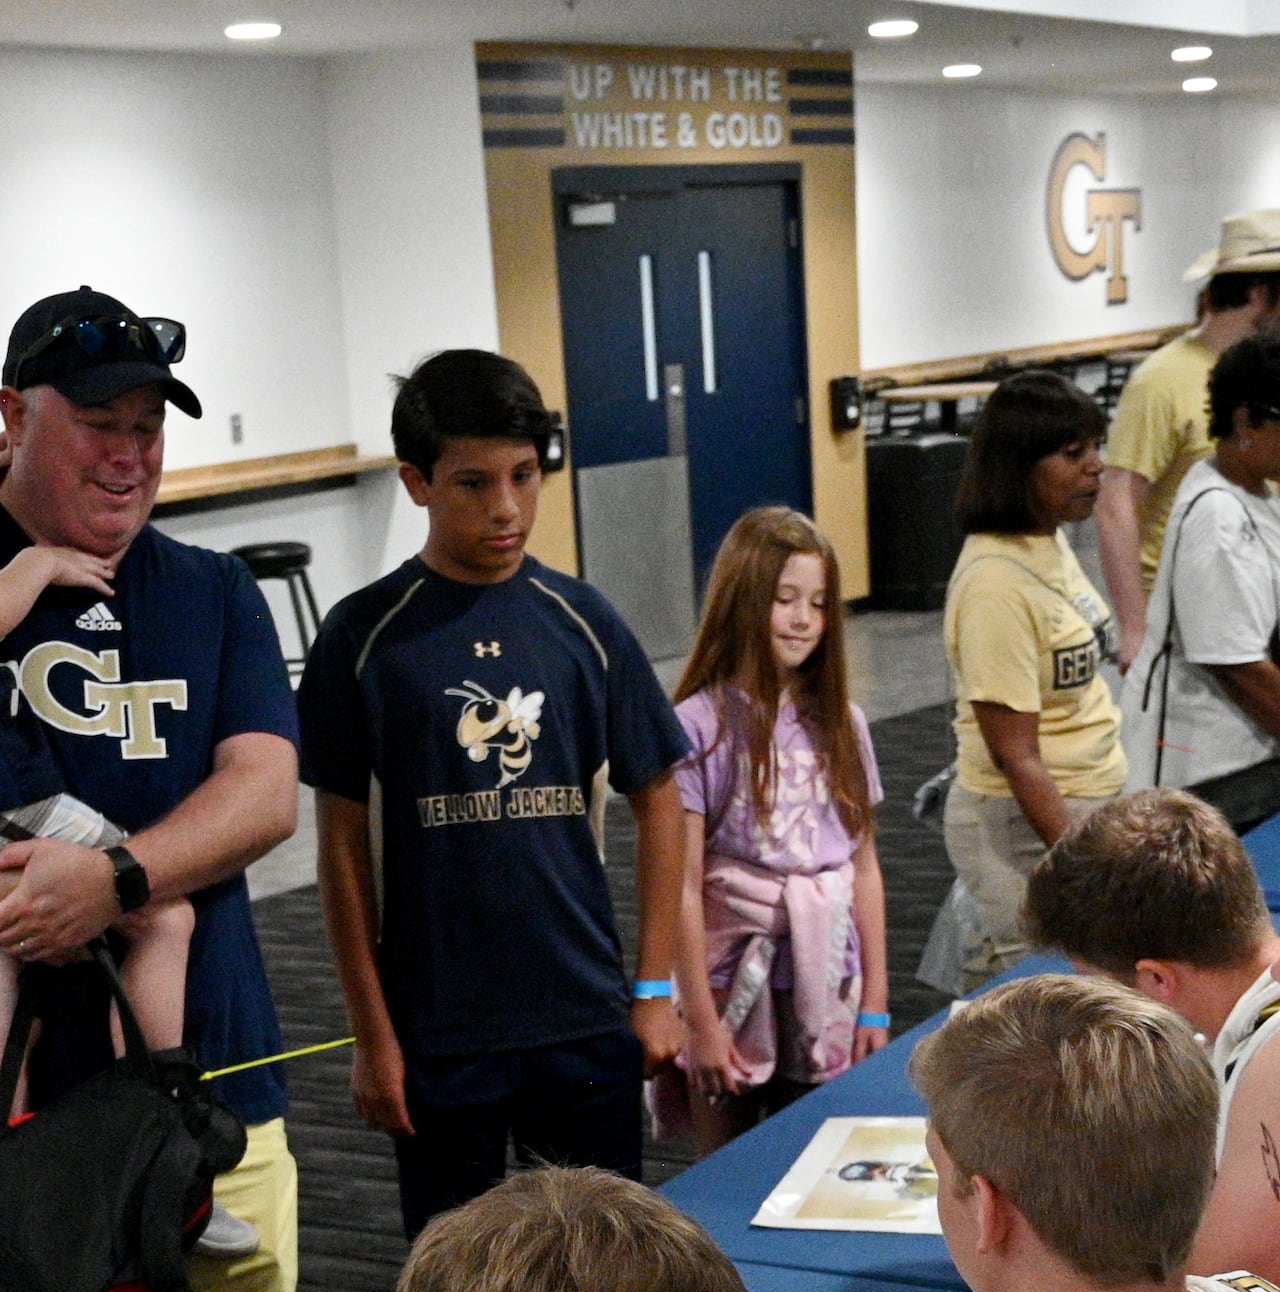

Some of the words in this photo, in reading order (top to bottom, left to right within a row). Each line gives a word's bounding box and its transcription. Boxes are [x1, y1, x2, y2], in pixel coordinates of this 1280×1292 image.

[569, 64, 614, 100] UP
[626, 64, 712, 101] WITH
[723, 67, 783, 102] THE
[571, 112, 670, 148] WHITE
[676, 112, 698, 148] &
[706, 112, 784, 149] GOLD
[1046, 130, 1143, 306] GT
[75, 619, 123, 632] adidas
[20, 640, 188, 761] GT
[417, 790, 502, 828] YELLOW
[506, 786, 587, 819] JACKETS
